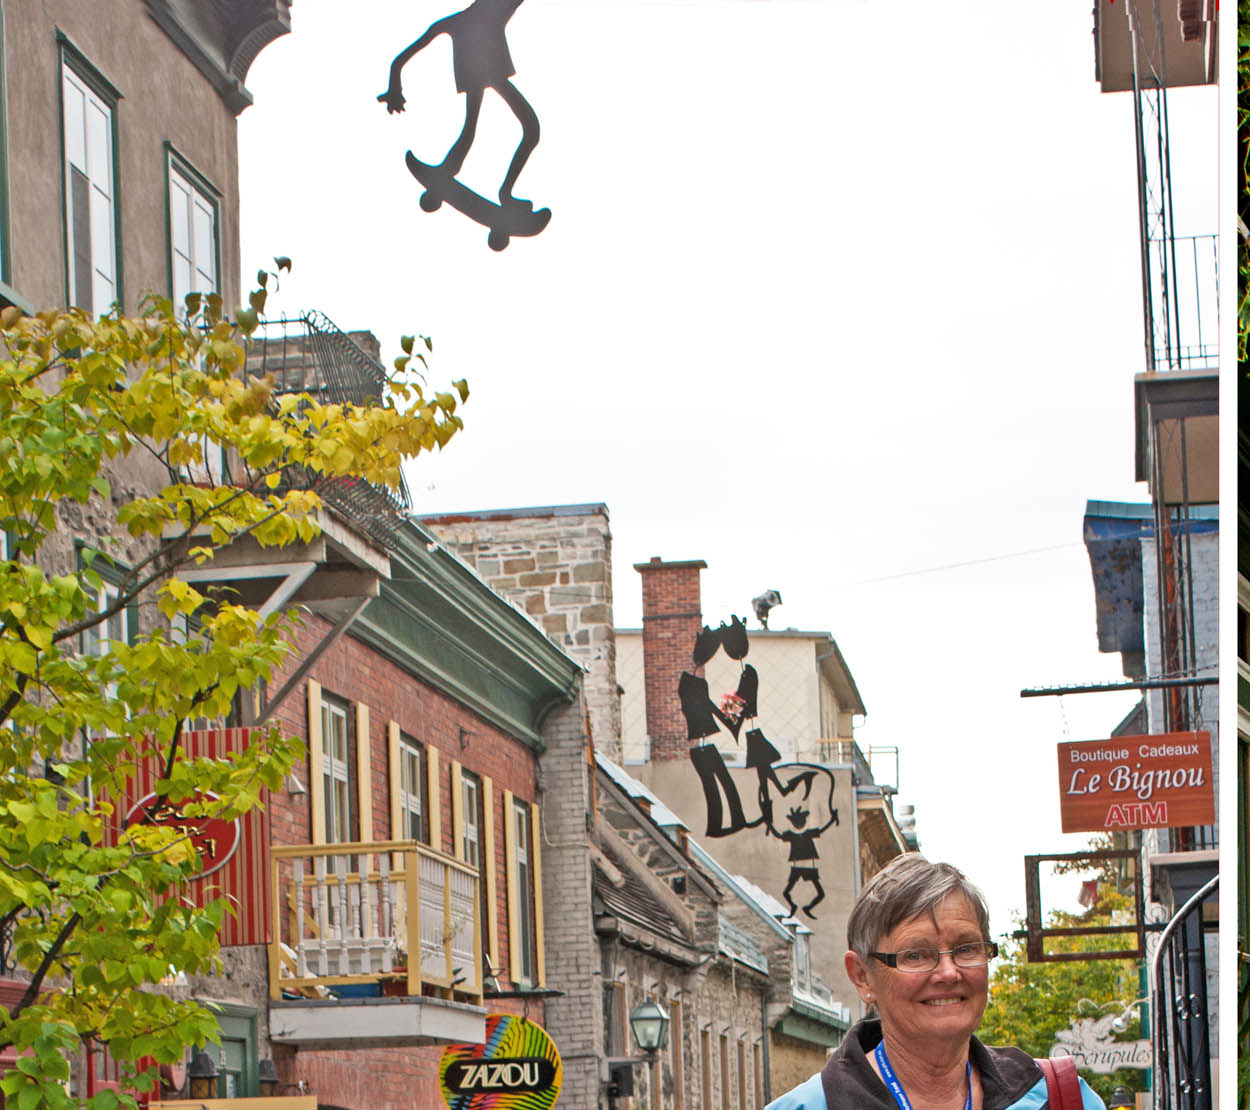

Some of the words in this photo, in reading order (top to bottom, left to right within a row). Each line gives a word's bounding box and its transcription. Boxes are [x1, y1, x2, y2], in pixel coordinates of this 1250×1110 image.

[1070, 748, 1129, 763] Boutique
[1138, 743, 1199, 758] Cadeaux
[1067, 767, 1101, 795] Le
[1107, 763, 1205, 800] Bignou
[1104, 801, 1168, 827] ATM
[1050, 1043, 1151, 1071] Scrupules
[459, 1062, 540, 1089] ZAZOU
